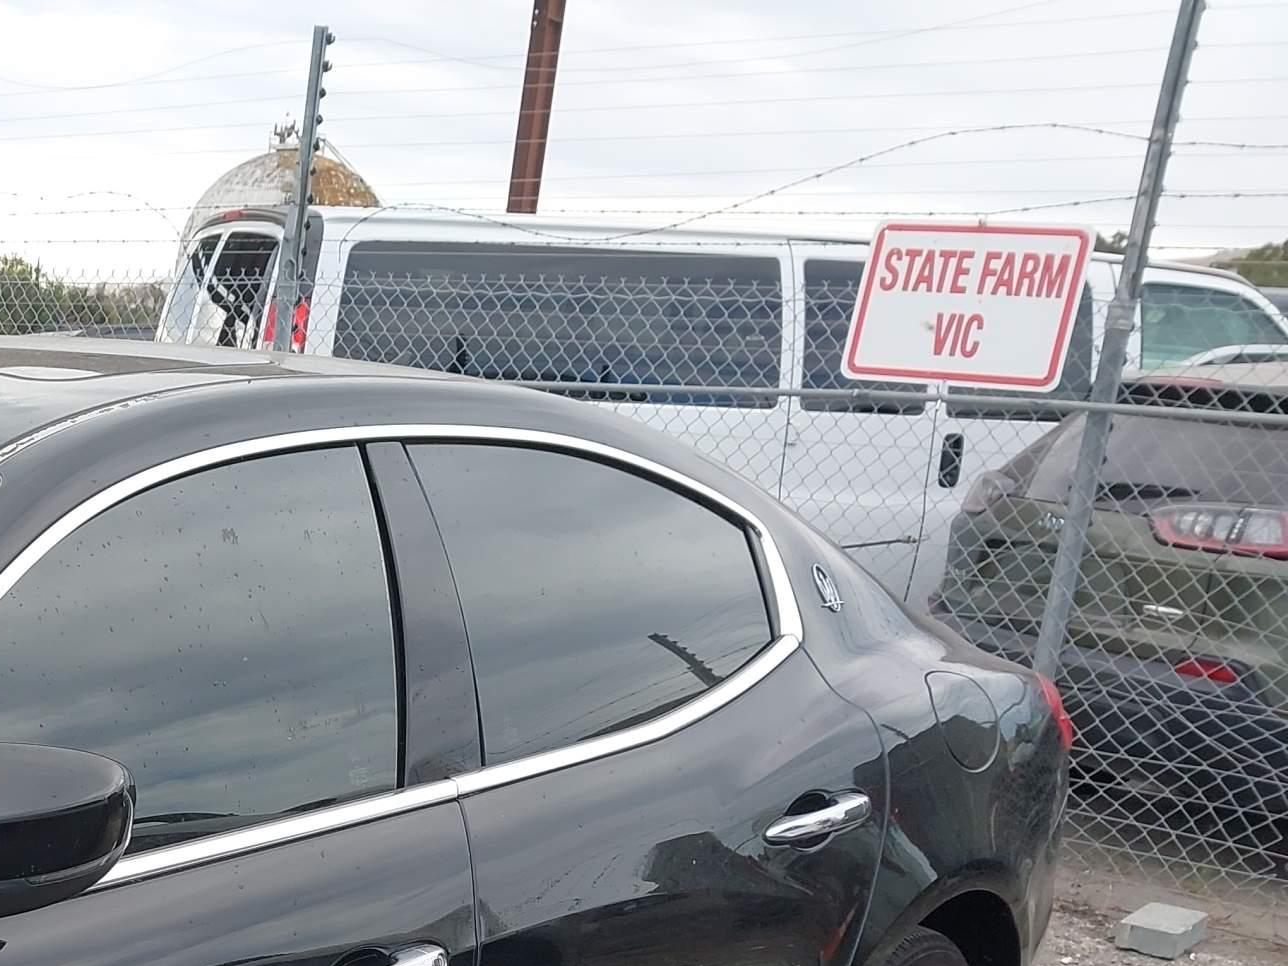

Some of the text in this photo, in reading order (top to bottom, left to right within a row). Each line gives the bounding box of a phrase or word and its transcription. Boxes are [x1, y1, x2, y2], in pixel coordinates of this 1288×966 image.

[879, 247, 1072, 298] STATE FARM
[932, 312, 984, 359] VIC
